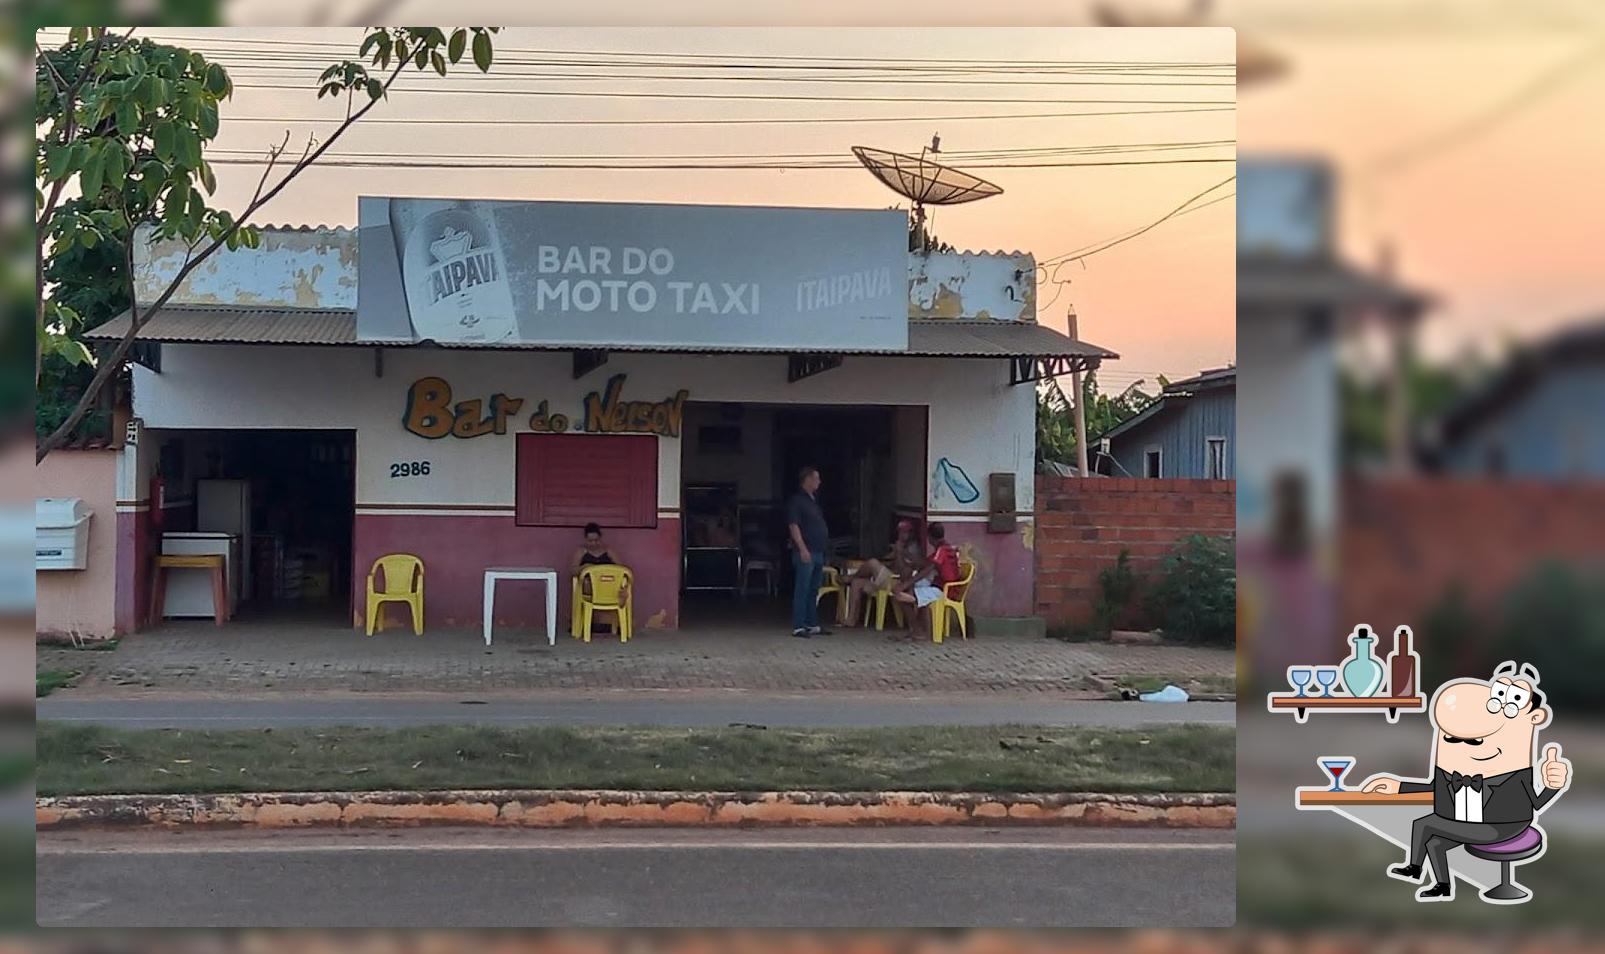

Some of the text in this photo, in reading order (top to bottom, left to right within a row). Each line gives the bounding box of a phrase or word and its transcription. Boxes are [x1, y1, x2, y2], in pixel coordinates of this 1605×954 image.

[538, 245, 675, 275] BAR DO
[536, 279, 760, 315] MOTO TAXI
[796, 266, 892, 313] ITAIPAVA
[402, 376, 524, 440] Bar
[529, 399, 569, 433] do
[390, 460, 431, 478] 2986
